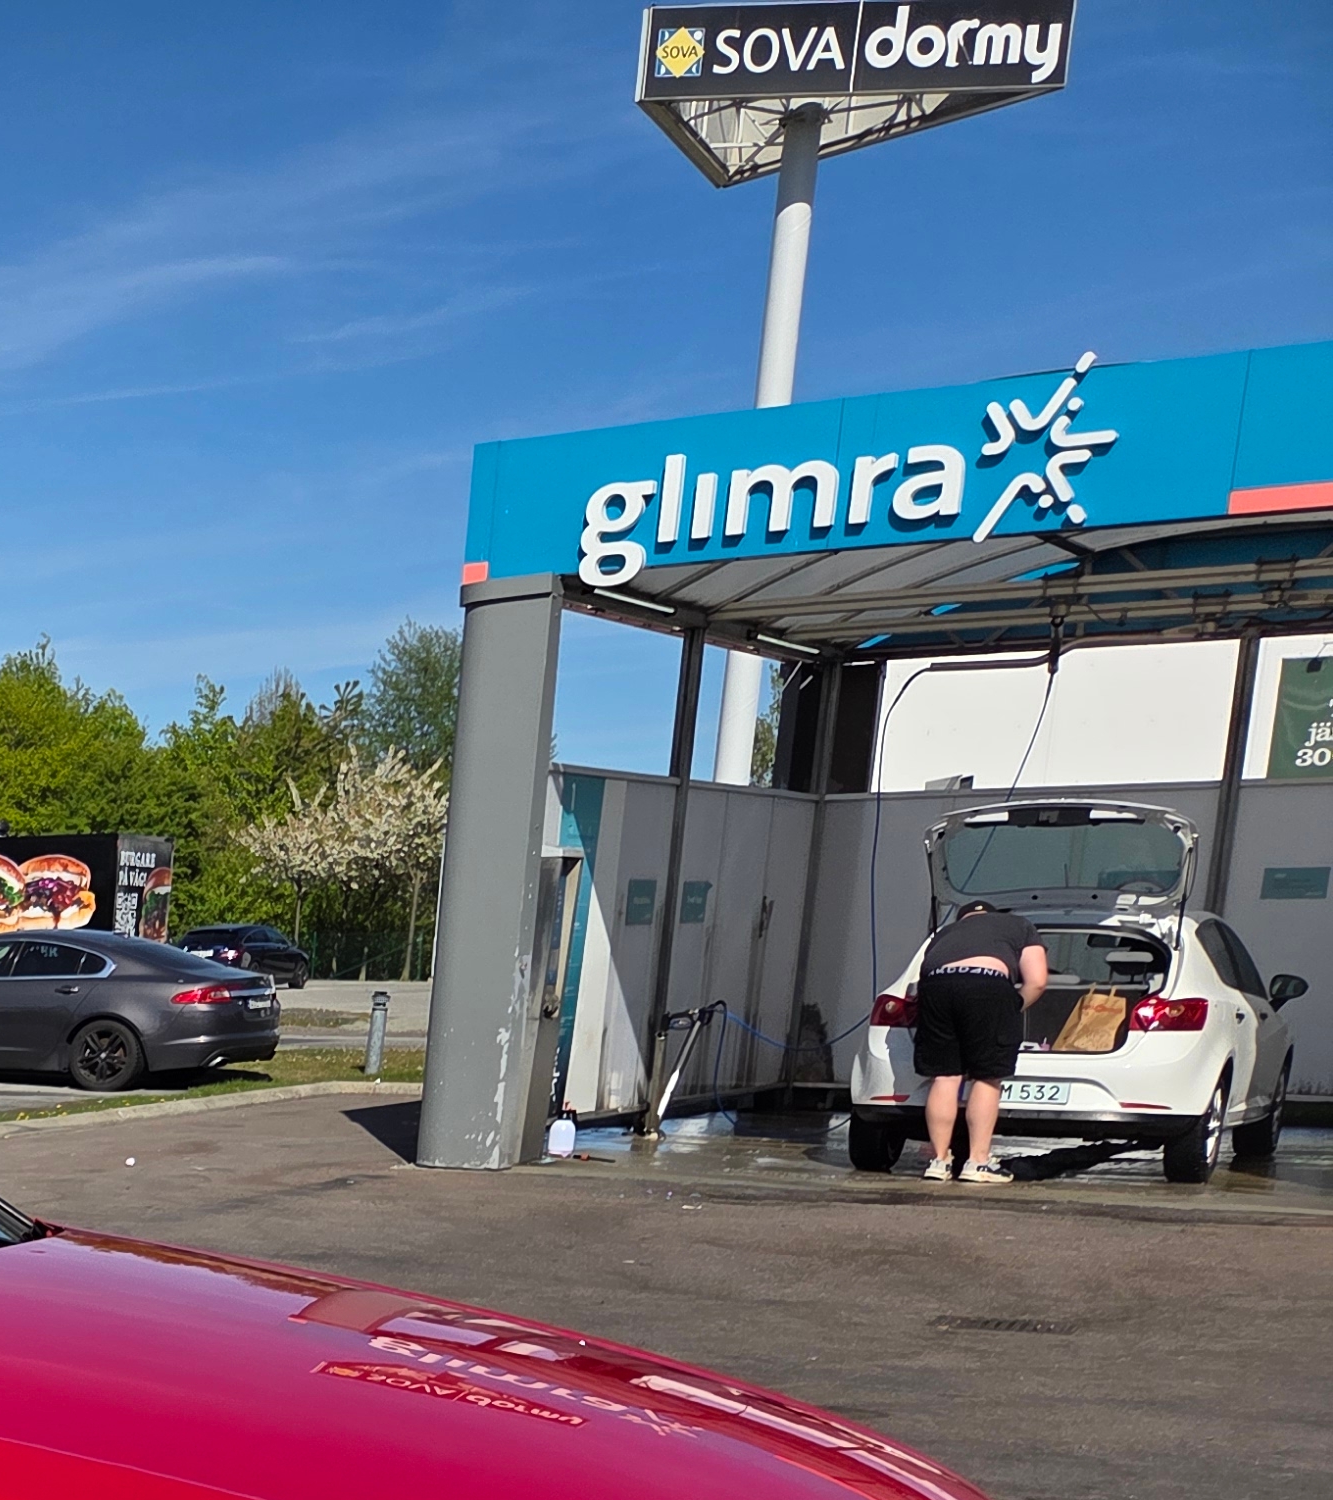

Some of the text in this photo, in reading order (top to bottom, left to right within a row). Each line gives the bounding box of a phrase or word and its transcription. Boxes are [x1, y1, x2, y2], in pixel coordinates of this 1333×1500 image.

[661, 45, 699, 60] SOVA
[712, 26, 846, 75] SOVA
[864, 5, 1063, 84] dormy
[578, 444, 965, 588] glimra
[119, 850, 156, 868] BURGARE
[118, 866, 129, 886] PÅ
[1019, 1084, 1061, 1101] 532
